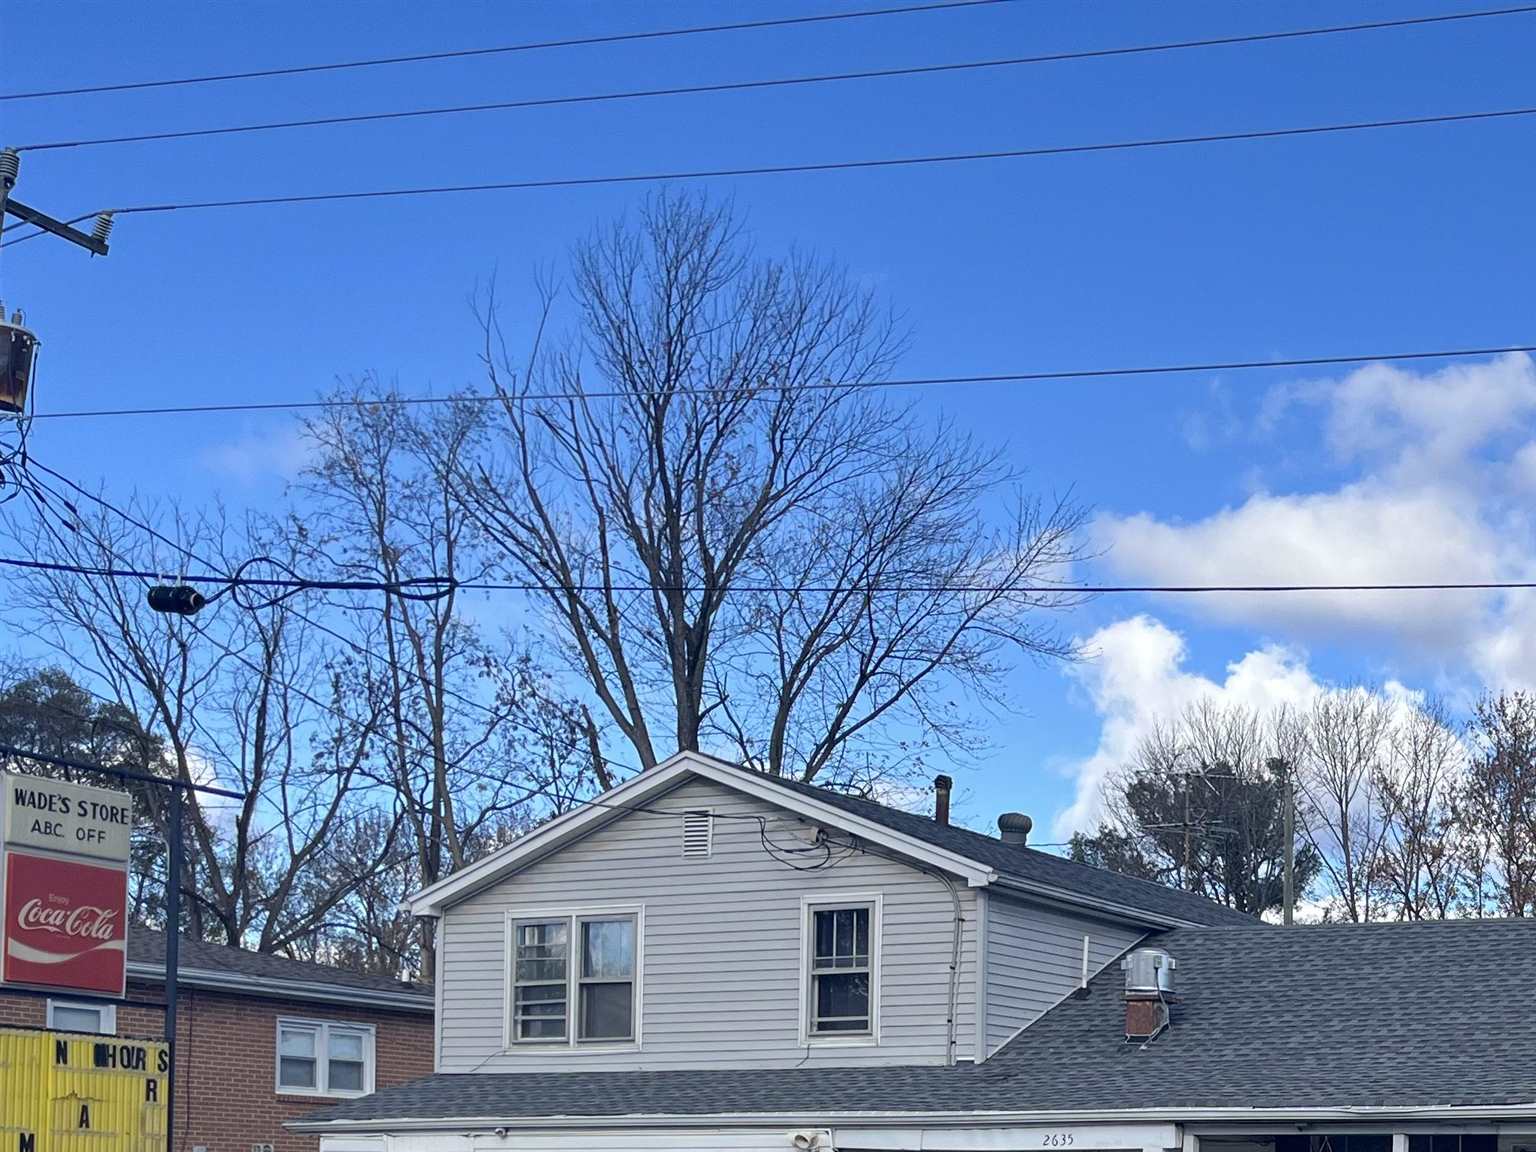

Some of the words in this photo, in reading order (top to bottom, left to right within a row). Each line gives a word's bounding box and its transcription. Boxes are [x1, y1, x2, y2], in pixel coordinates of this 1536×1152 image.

[15, 788, 71, 814] WADE'S
[78, 801, 128, 825] STORE
[76, 828, 106, 844] OFF
[1043, 1134, 1074, 1147] 2635
